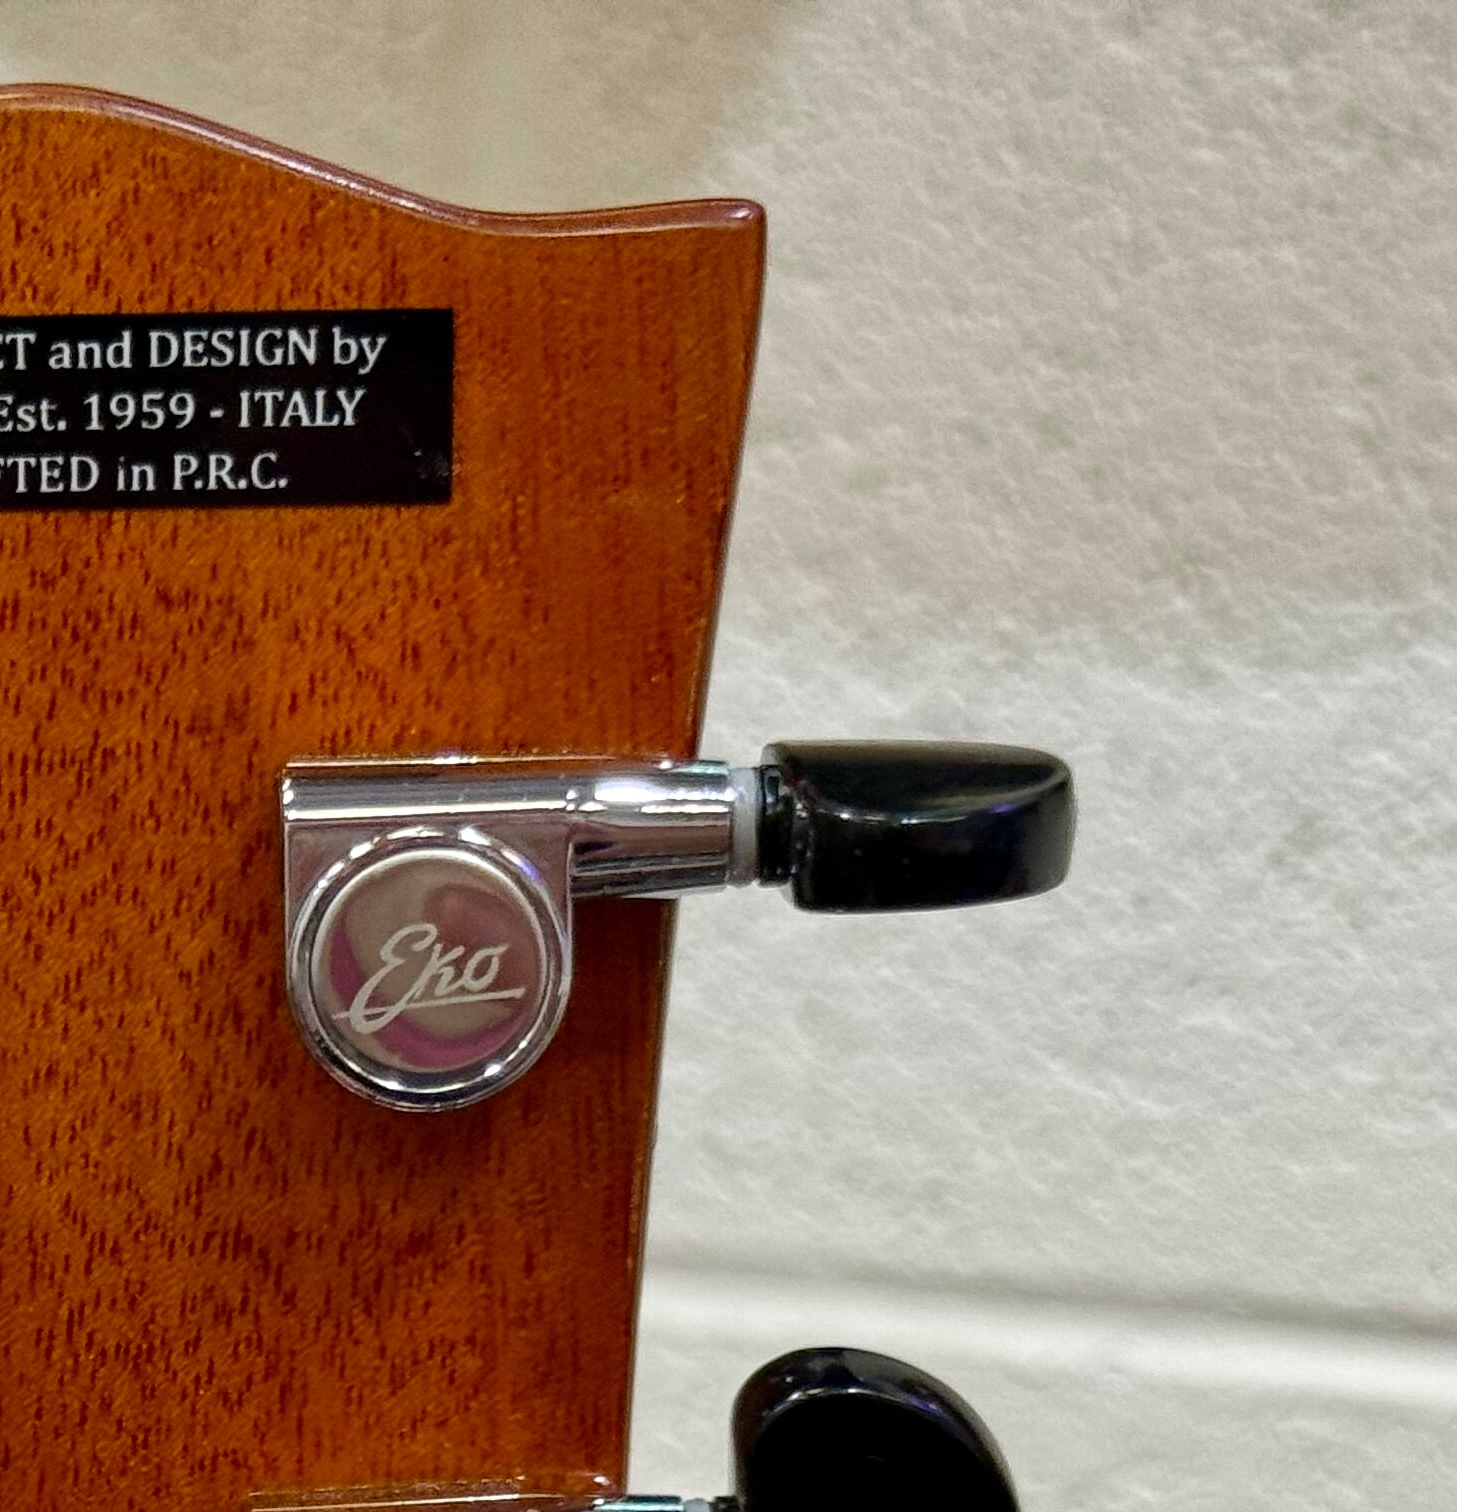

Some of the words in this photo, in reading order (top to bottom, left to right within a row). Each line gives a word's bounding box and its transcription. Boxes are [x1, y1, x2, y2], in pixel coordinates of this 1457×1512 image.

[48, 330, 132, 370] and
[148, 328, 318, 368] DESIGN
[331, 326, 387, 375] by
[83, 391, 196, 431] 1959
[238, 388, 367, 428] ITALY
[116, 455, 157, 493] in
[172, 450, 290, 491] P.R.C.
[342, 922, 514, 1035] Eko
